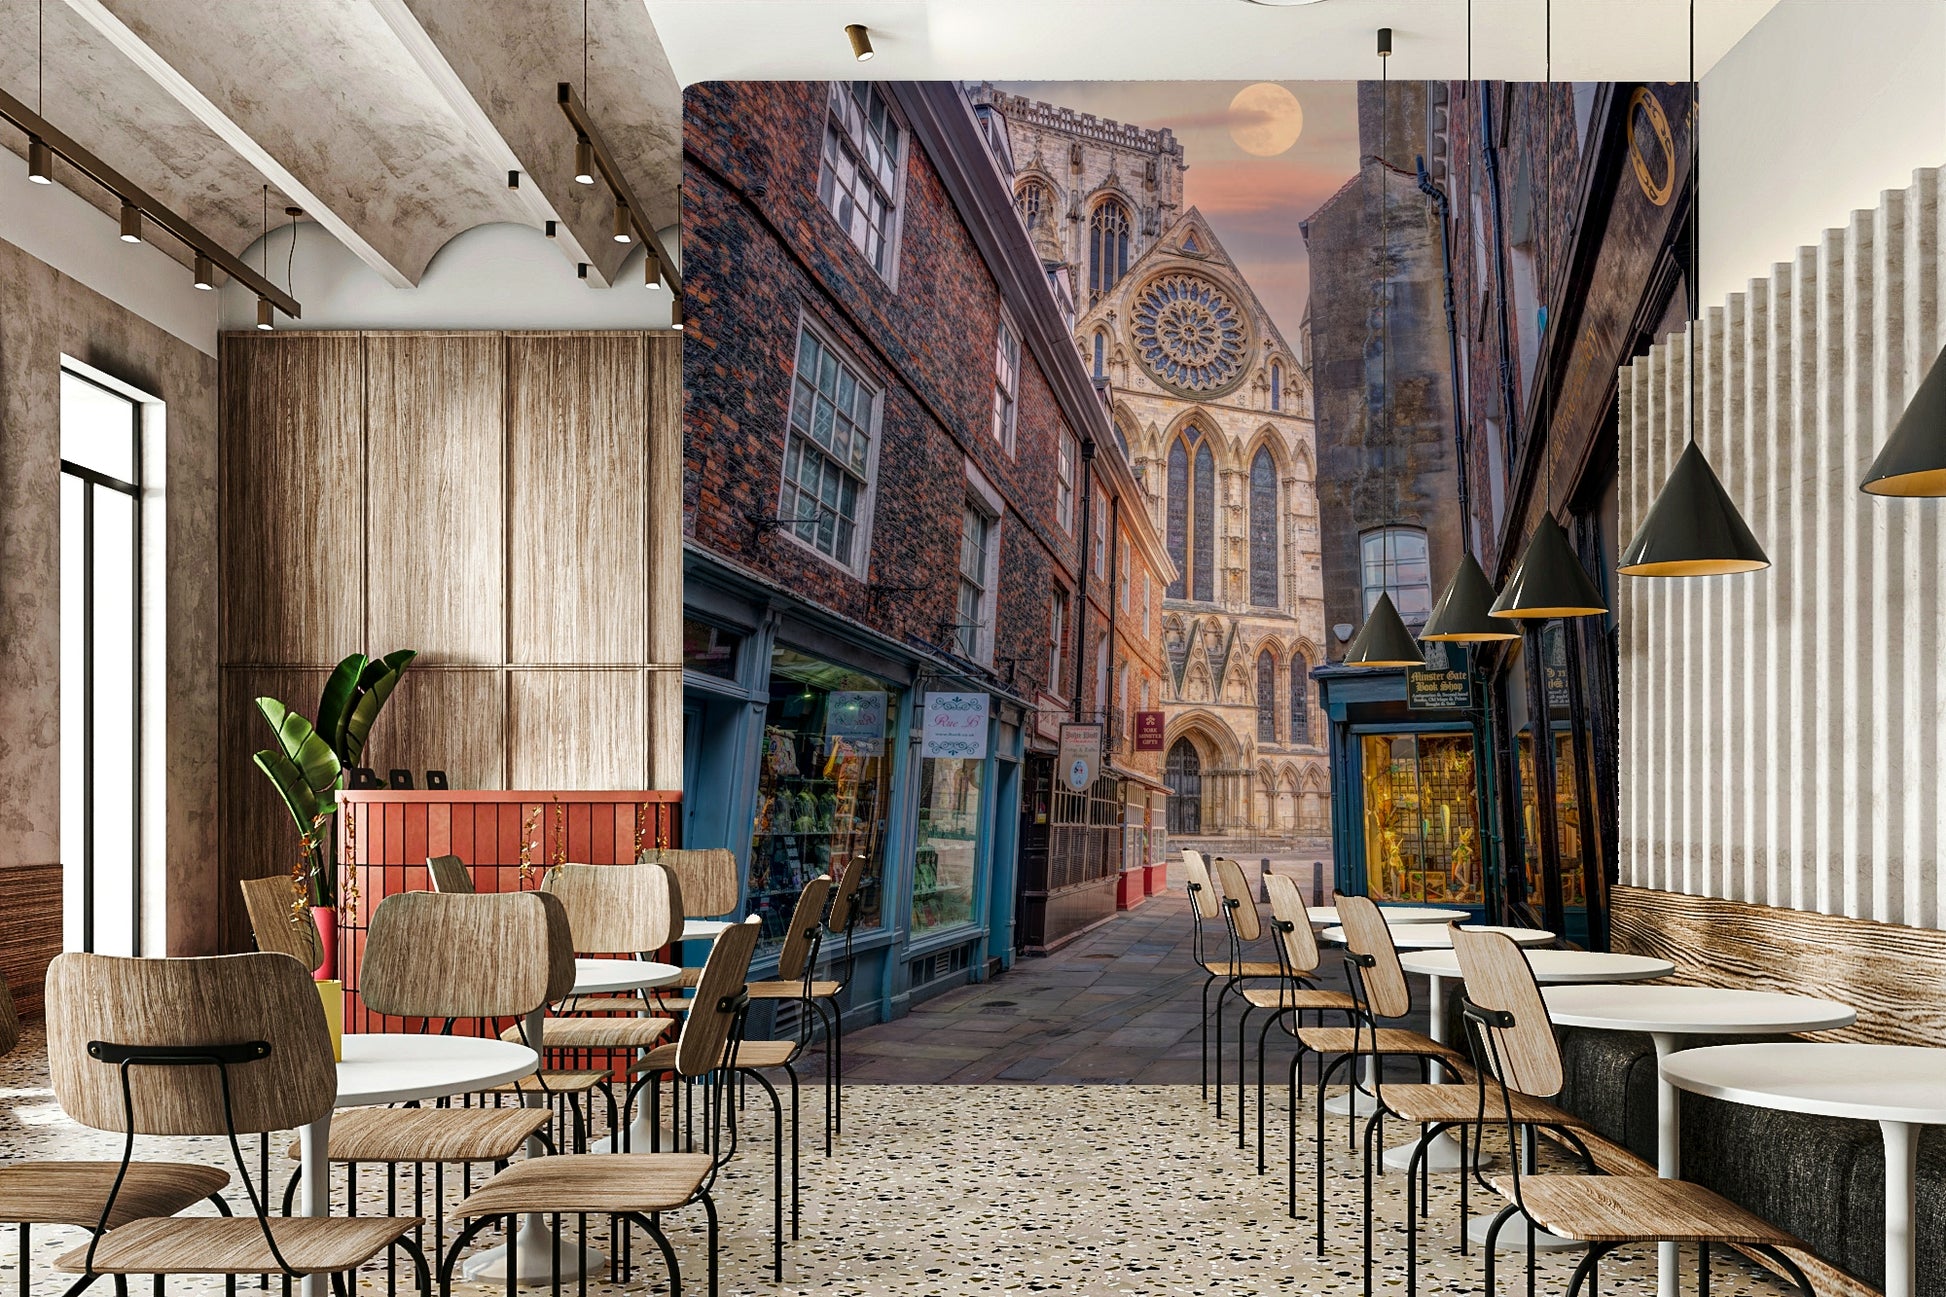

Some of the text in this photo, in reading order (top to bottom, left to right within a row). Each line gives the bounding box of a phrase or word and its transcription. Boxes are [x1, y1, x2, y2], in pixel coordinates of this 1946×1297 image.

[1411, 671, 1467, 682] Minster Gate
[1415, 681, 1463, 692] Book Shop
[928, 713, 959, 727] Rue
